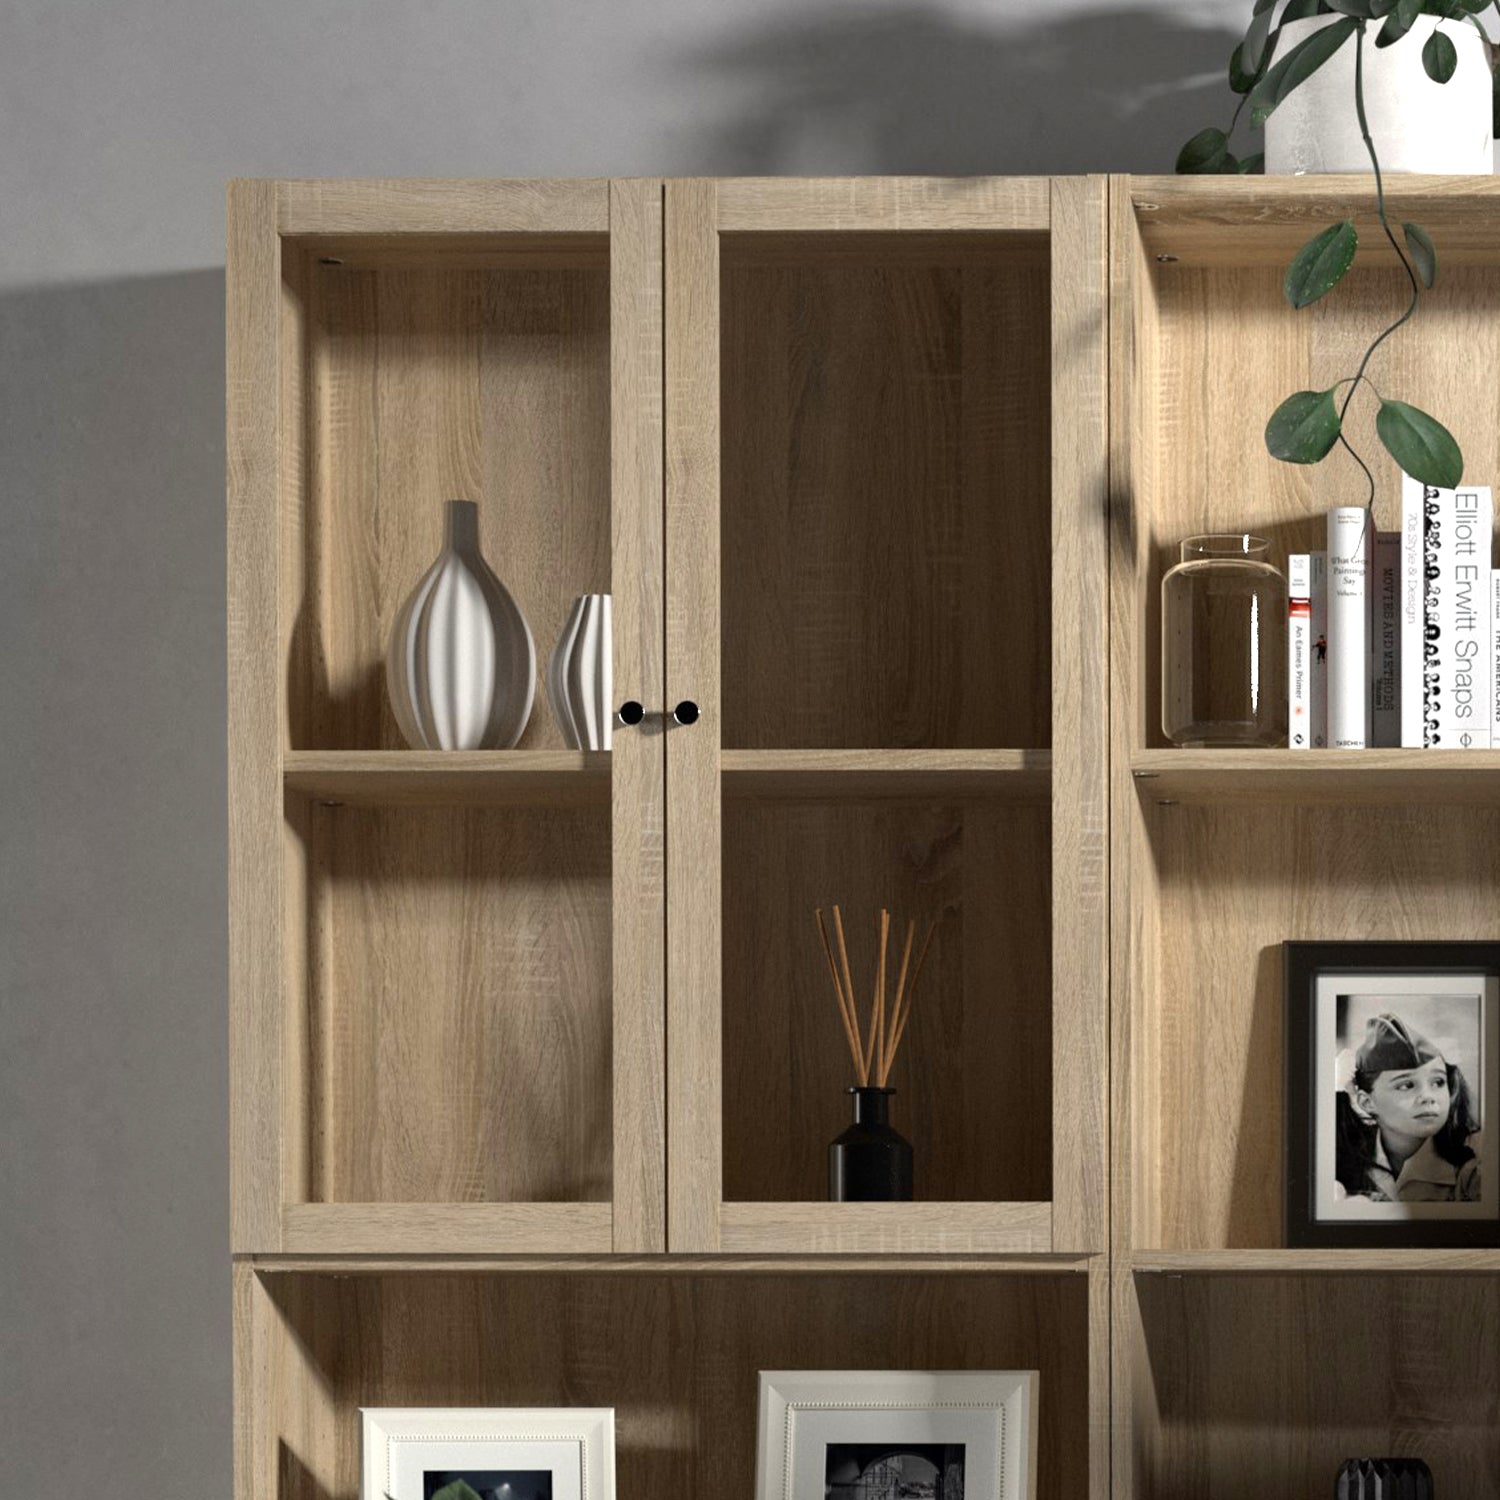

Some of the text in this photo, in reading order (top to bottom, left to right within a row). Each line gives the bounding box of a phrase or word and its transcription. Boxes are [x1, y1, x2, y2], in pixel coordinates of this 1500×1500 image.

[1343, 577, 1355, 585] Say
[1406, 513, 1418, 624] 70s Style & Design
[1451, 493, 1478, 718] Elliott Erwitt Snaps
[1296, 626, 1303, 637] An
[1295, 671, 1303, 699] Primer
[1384, 653, 1394, 711] METHODS
